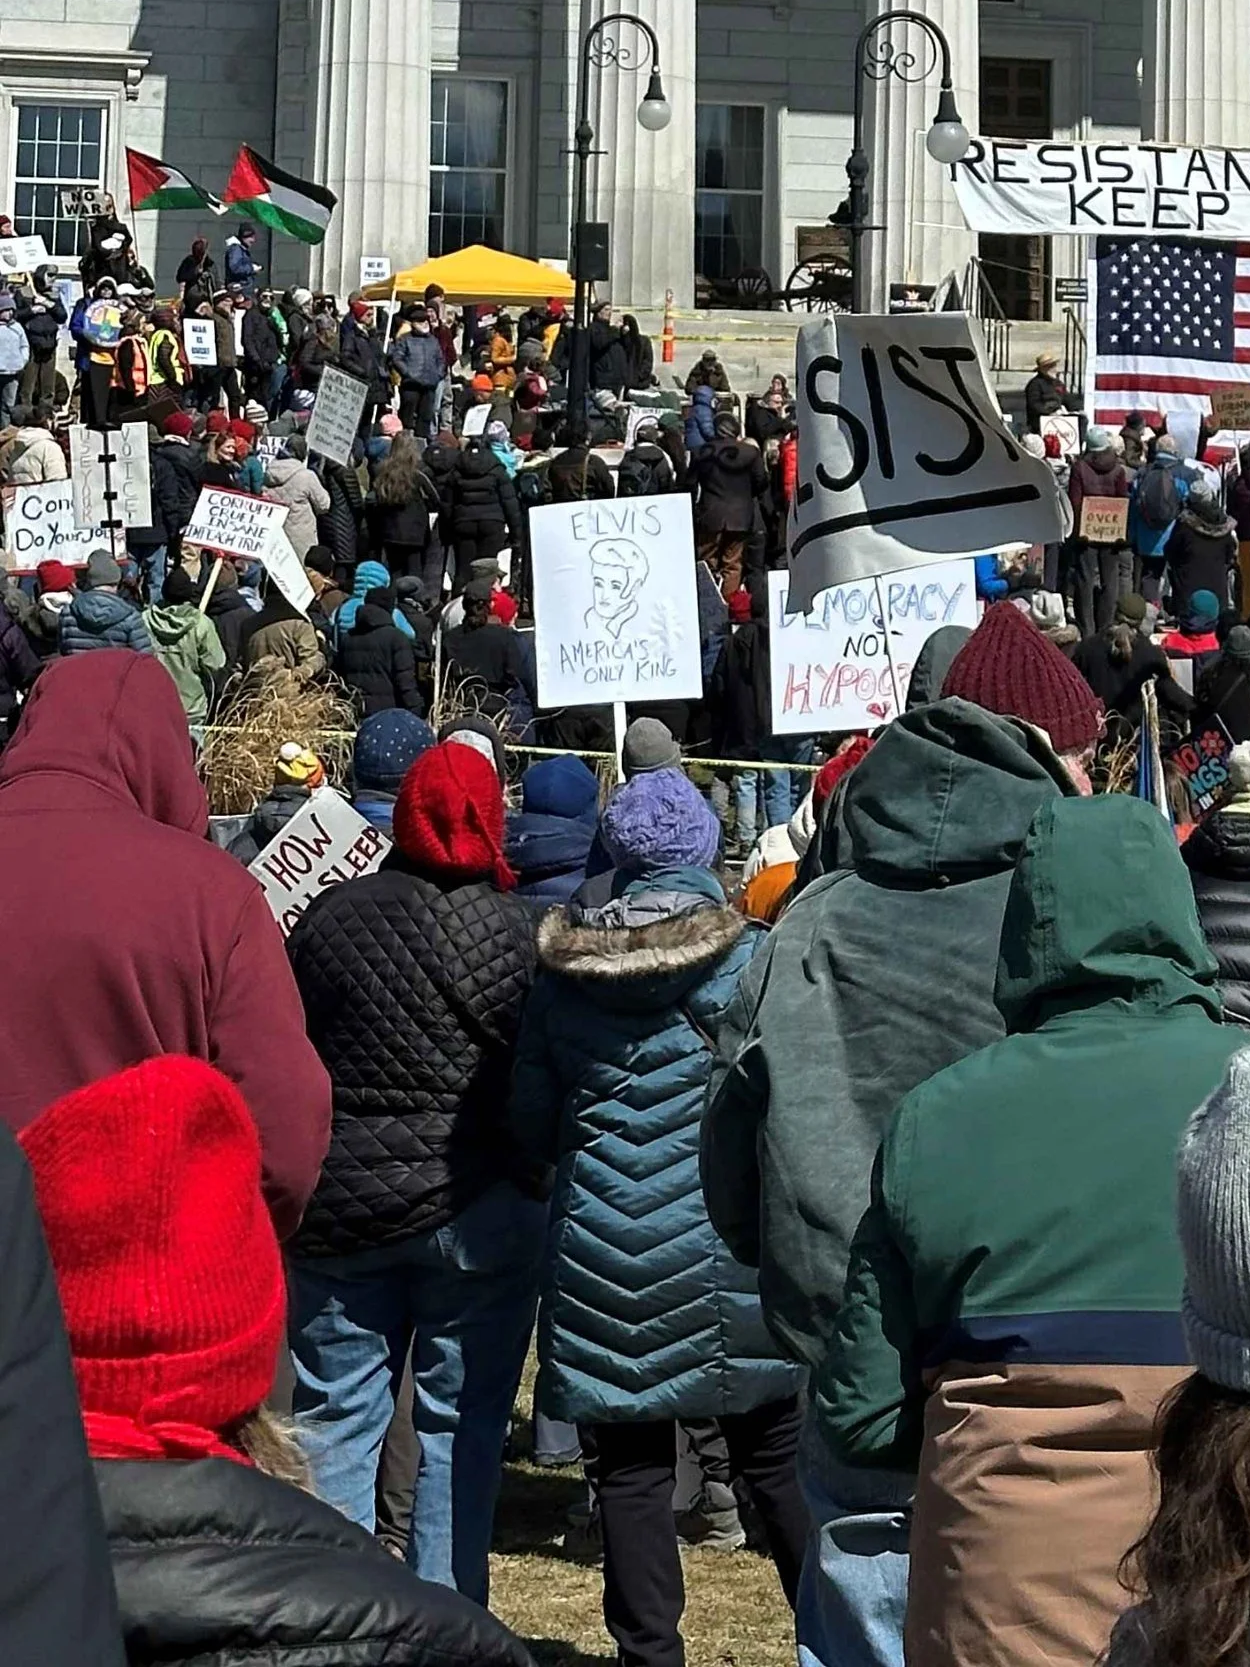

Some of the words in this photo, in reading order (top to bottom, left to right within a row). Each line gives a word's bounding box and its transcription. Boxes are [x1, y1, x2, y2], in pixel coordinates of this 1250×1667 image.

[65, 203, 102, 215] WAR
[71, 191, 95, 203] NO
[1069, 184, 1230, 231] KEEP
[16, 529, 44, 551] Do
[48, 522, 82, 550] Your
[572, 505, 661, 540] ELVIS
[560, 639, 649, 674] AMERICA'S
[843, 631, 903, 657] NOT
[584, 664, 624, 684] ONLY
[636, 655, 677, 682] KING
[262, 812, 333, 892] HOW
